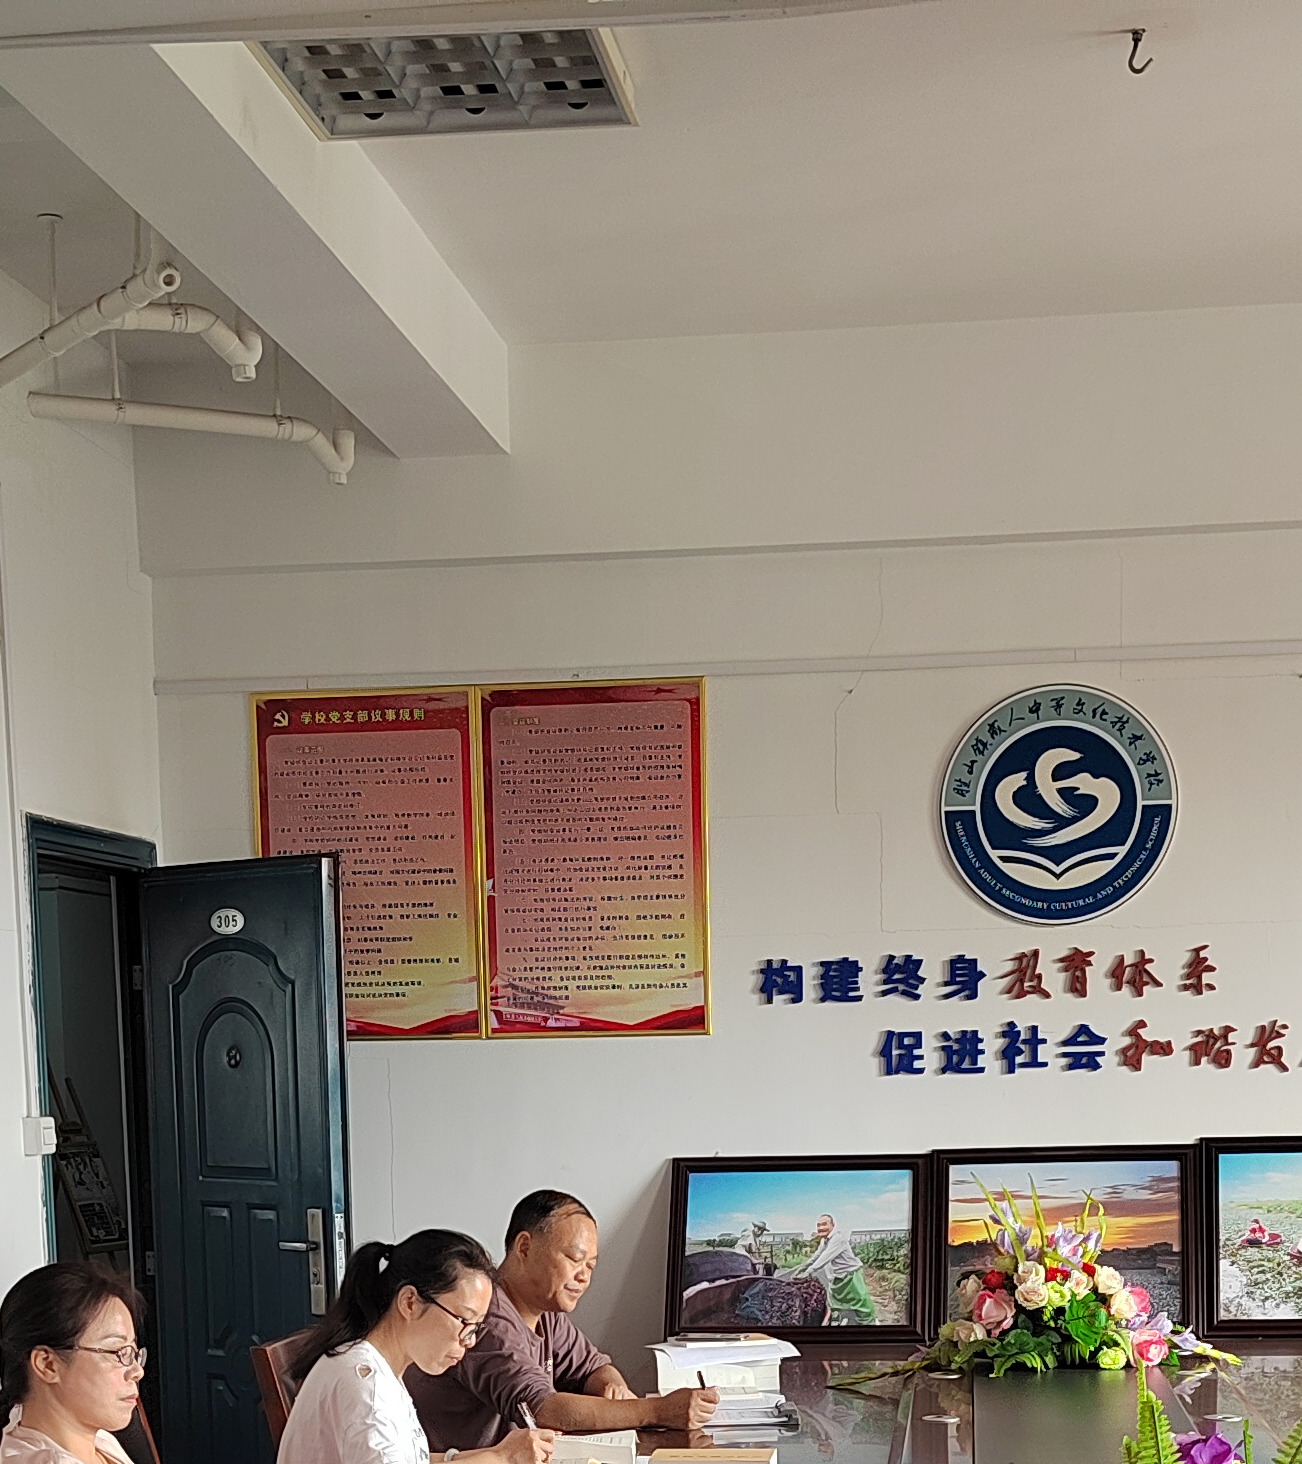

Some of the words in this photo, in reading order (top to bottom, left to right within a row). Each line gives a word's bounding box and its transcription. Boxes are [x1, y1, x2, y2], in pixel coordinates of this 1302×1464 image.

[300, 708, 425, 725] 学校党支部议事规则
[952, 696, 1164, 798] 胜山镇成人中等文化技术学校
[977, 867, 1002, 891] ADULT
[1000, 887, 1049, 911] SECONDARY
[1050, 895, 1096, 911] CULTURAL
[1096, 885, 1114, 899] AND
[1113, 850, 1149, 888] TECHNICAL
[1146, 814, 1162, 850] SCHOOL
[216, 914, 238, 929] 305
[758, 944, 1219, 1004] 构建终身教育体系
